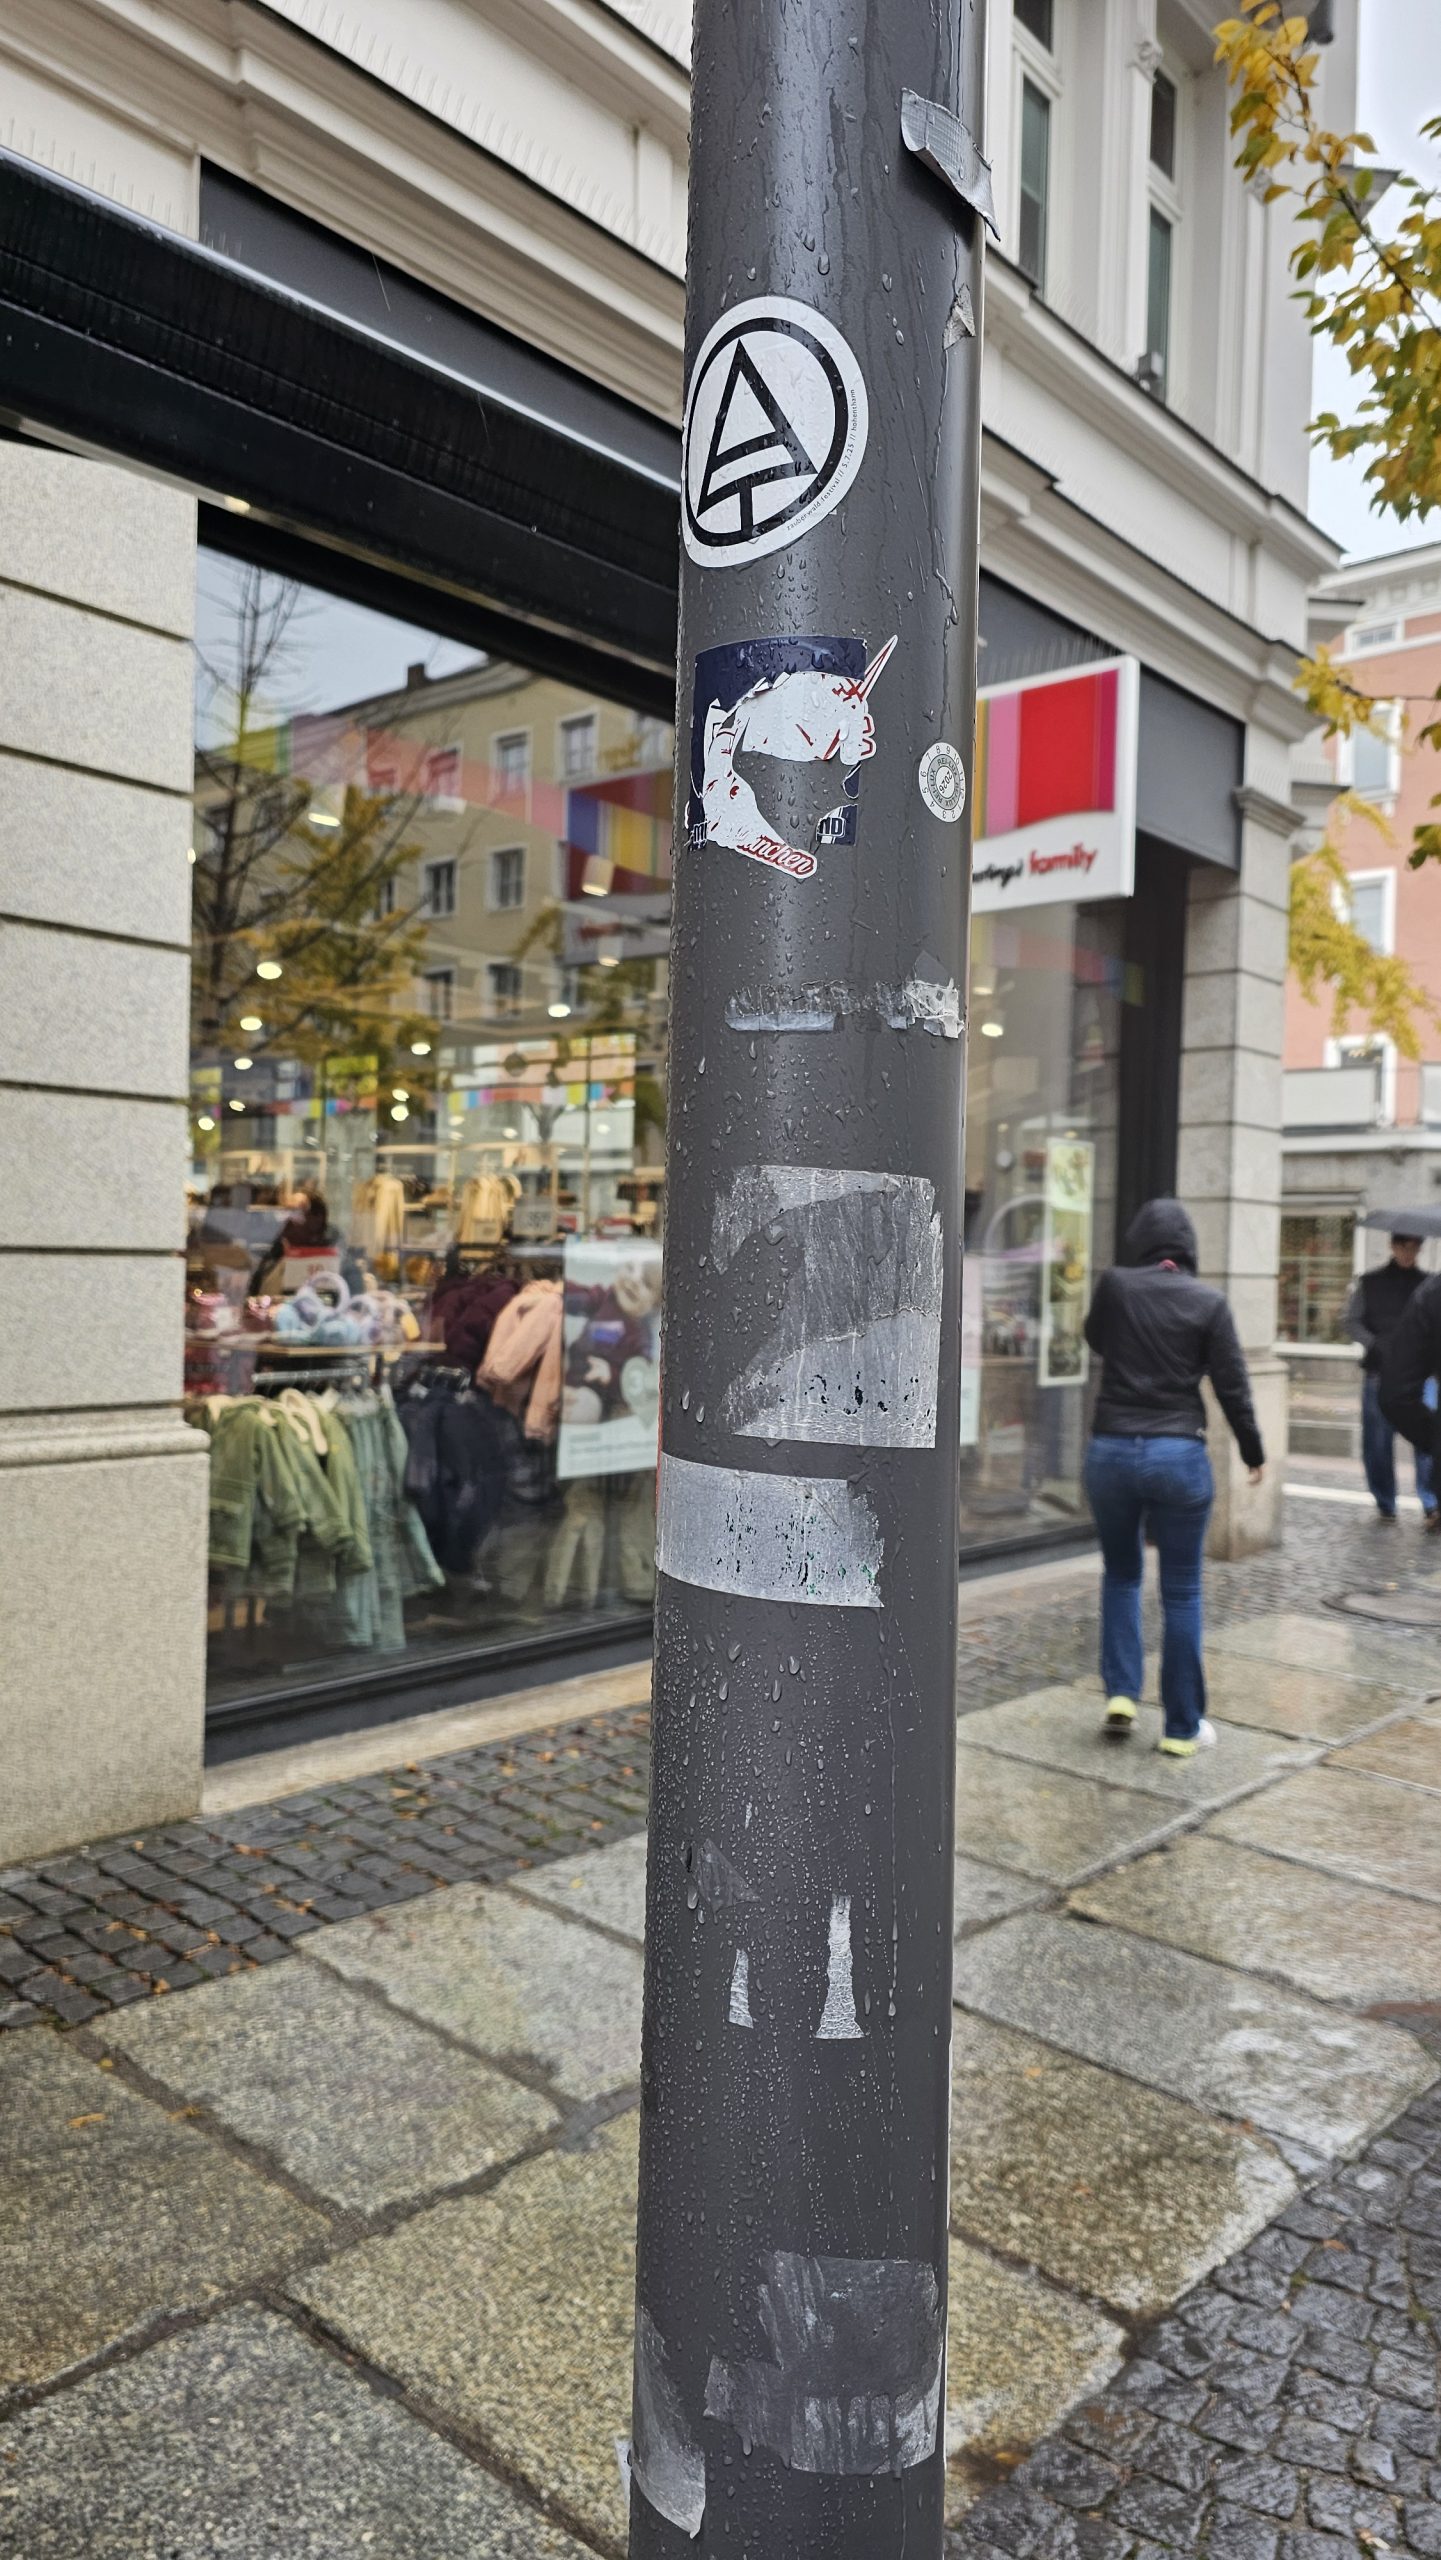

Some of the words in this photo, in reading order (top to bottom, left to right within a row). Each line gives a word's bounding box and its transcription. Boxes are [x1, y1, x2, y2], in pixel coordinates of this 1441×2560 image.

[787, 501, 822, 531] zauberwald
[821, 478, 840, 502] festival
[842, 443, 855, 468] 5.7.25
[850, 389, 858, 431] hohenthann
[939, 770, 953, 793] 2026
[1029, 843, 1098, 876] family
